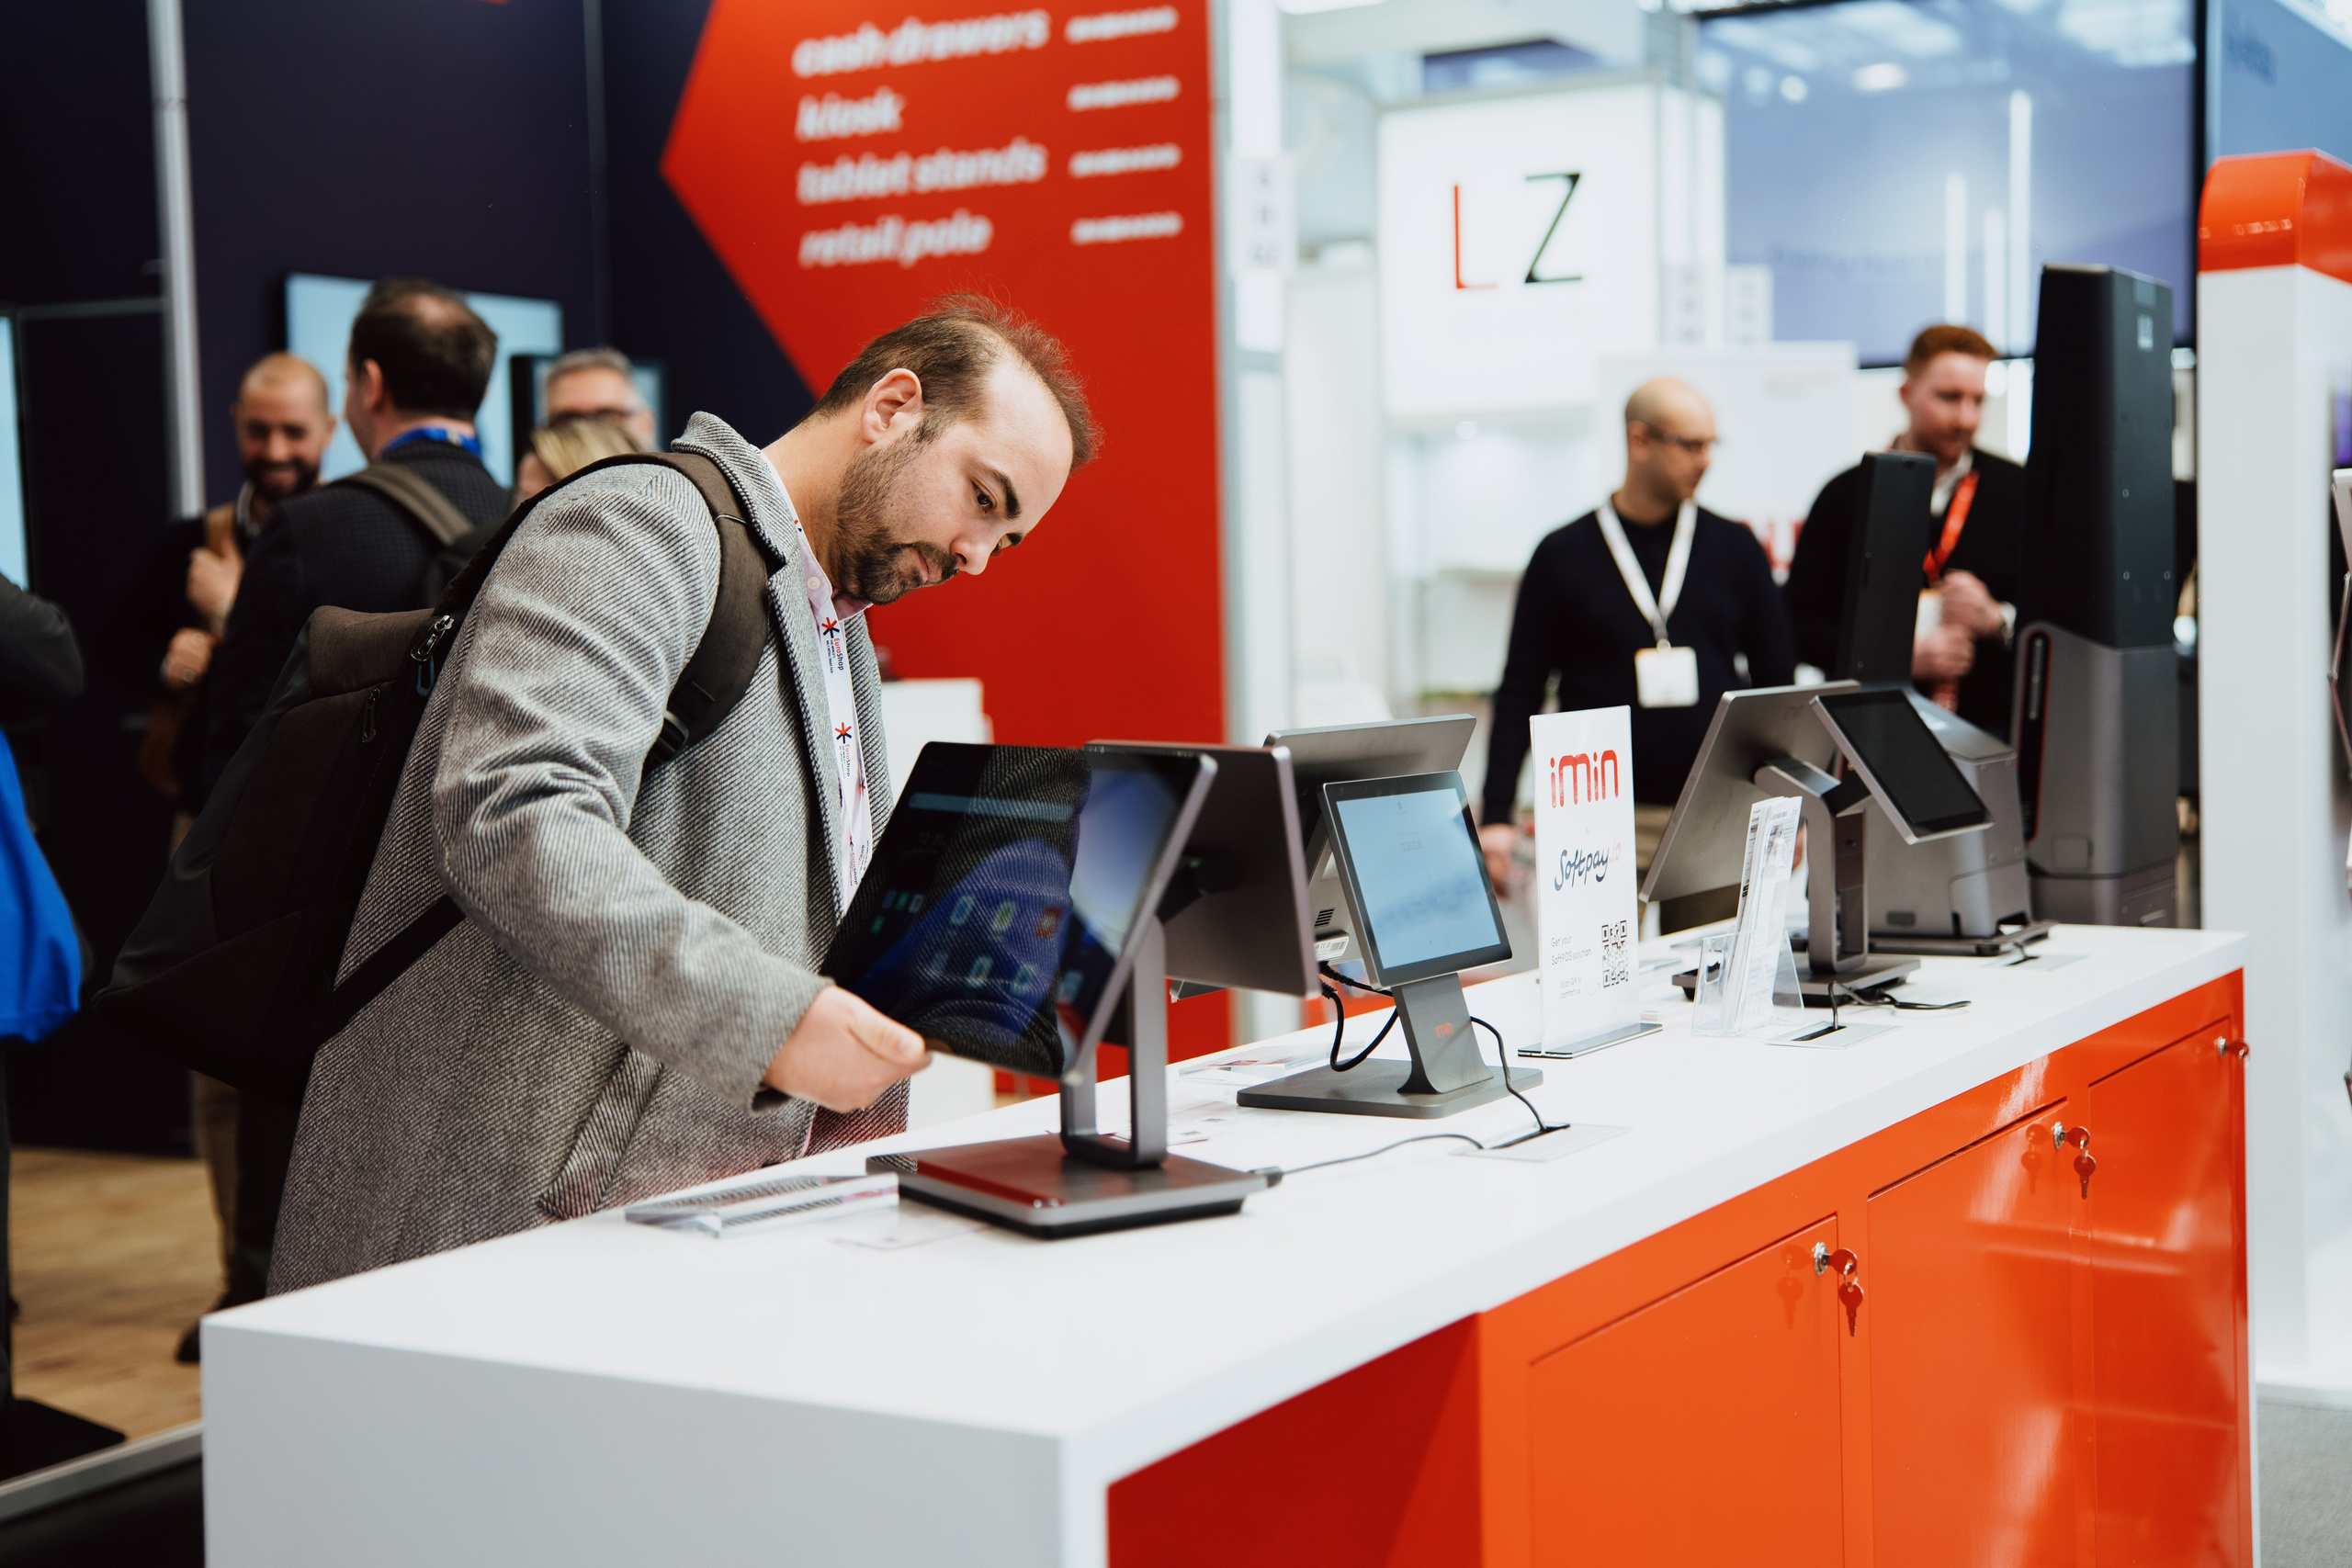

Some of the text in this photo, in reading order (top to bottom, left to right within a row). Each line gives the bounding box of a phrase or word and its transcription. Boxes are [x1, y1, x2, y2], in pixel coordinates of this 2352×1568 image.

[791, 21, 887, 77] cash
[888, 8, 1050, 65] drawers
[796, 86, 905, 141] kiosk
[797, 152, 911, 204] tablet
[913, 136, 1048, 192] stands
[798, 208, 993, 268] retail pole
[833, 637, 844, 671] EuroShop
[1550, 750, 1619, 808] imin
